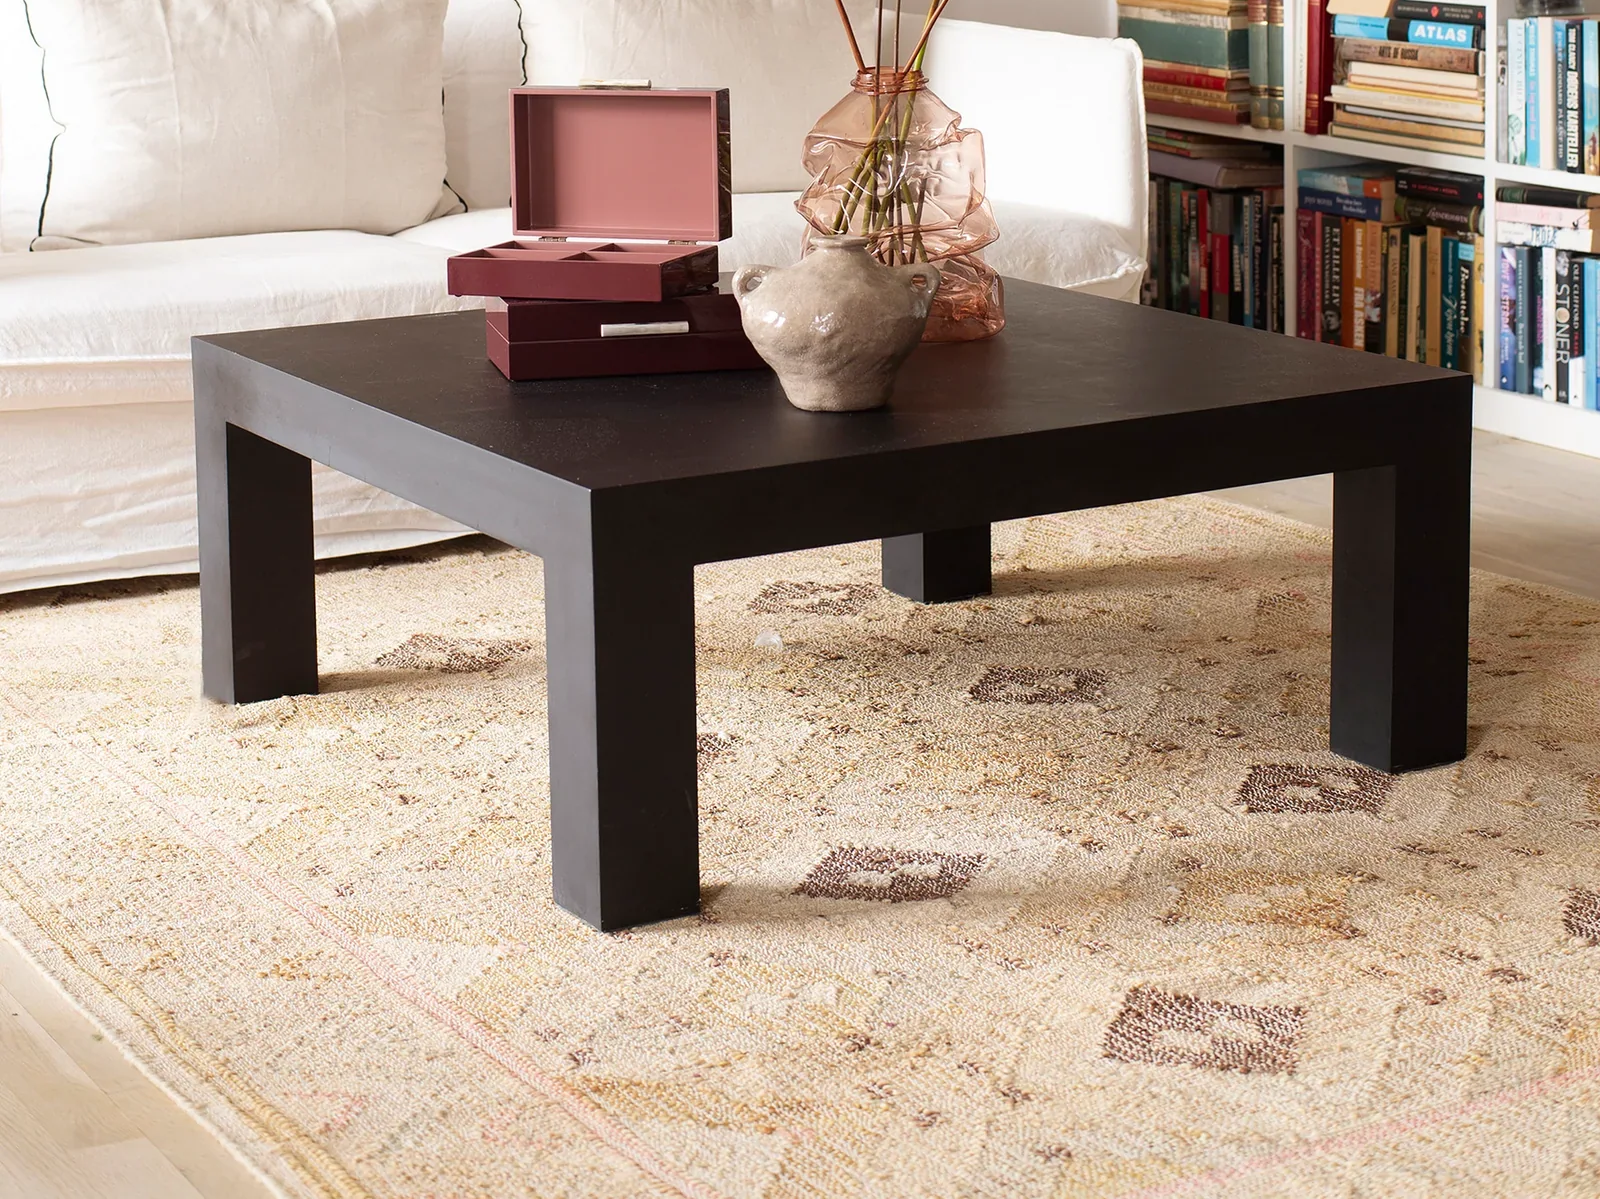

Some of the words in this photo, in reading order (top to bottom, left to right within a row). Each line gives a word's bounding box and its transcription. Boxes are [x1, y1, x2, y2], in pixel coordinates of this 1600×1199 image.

[1414, 24, 1467, 43] ATLAS
[1568, 28, 1577, 43] TOM
[1378, 45, 1391, 58] ARTS
[1392, 47, 1400, 59] OF
[1401, 48, 1419, 61] RUSSIA
[1566, 71, 1579, 108] DØDENS
[1566, 110, 1579, 168] KARTELLER
[1332, 227, 1341, 245] ET
[1332, 247, 1341, 283] LILLE
[1572, 264, 1580, 280] OLE
[1332, 285, 1341, 307] LIV
[1354, 286, 1365, 308] FRA
[1459, 265, 1470, 335] Besættelse
[1572, 284, 1580, 329] CLIFFORD
[1354, 310, 1365, 347] ASKEN
[1556, 284, 1570, 364] STONER
